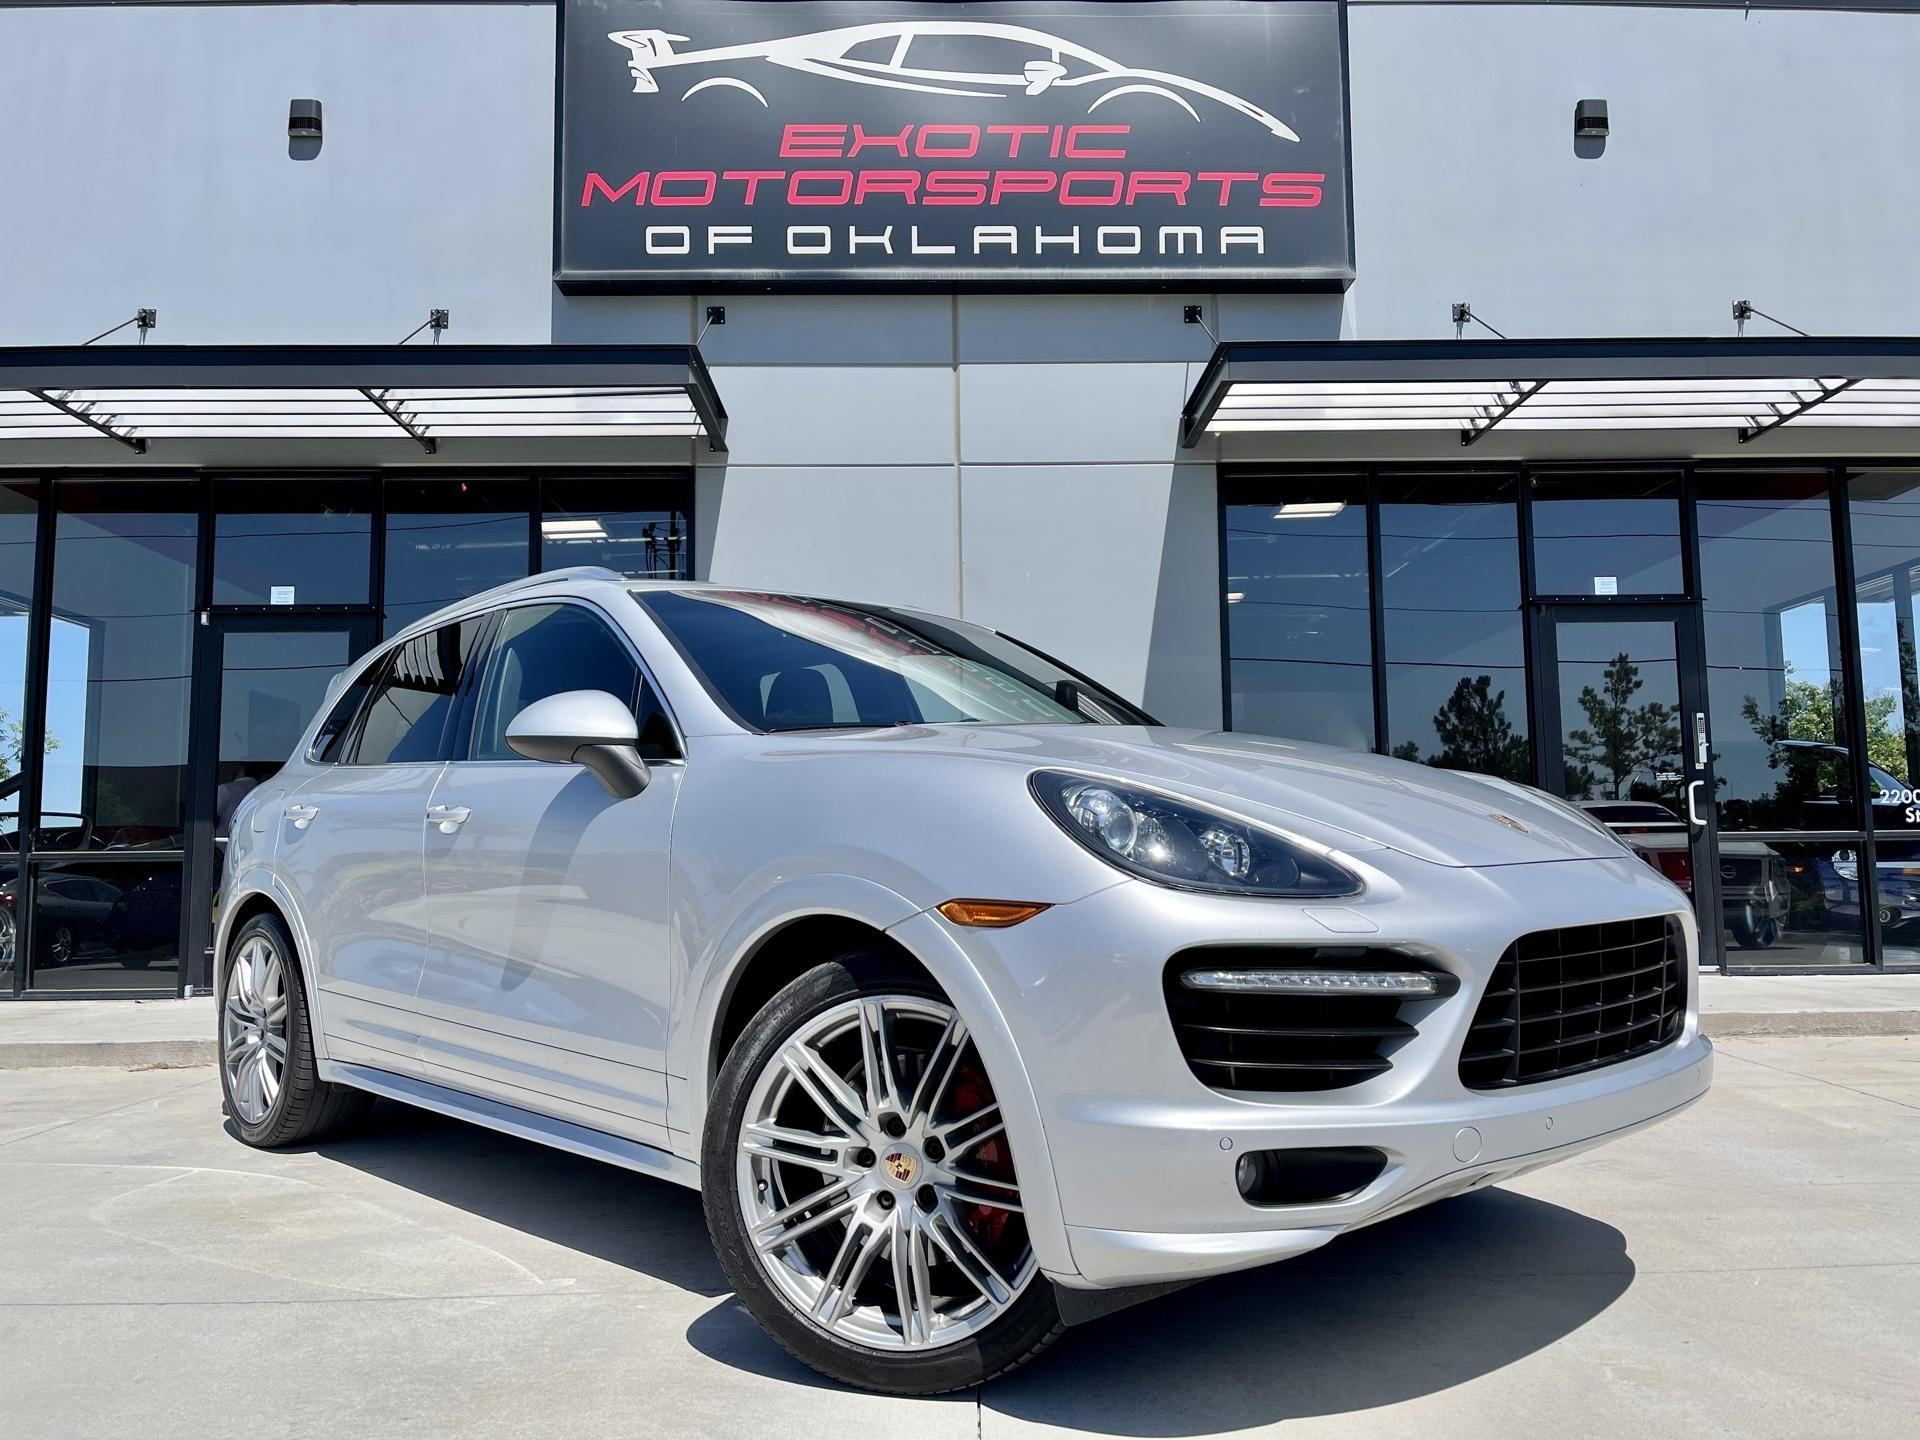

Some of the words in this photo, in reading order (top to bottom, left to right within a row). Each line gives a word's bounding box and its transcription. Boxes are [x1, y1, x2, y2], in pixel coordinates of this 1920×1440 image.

[779, 124, 1130, 159] EXOTIC
[580, 170, 1326, 208] MOTORSPORTS
[645, 225, 753, 256] OF
[786, 225, 1266, 256] OKLAHOMA
